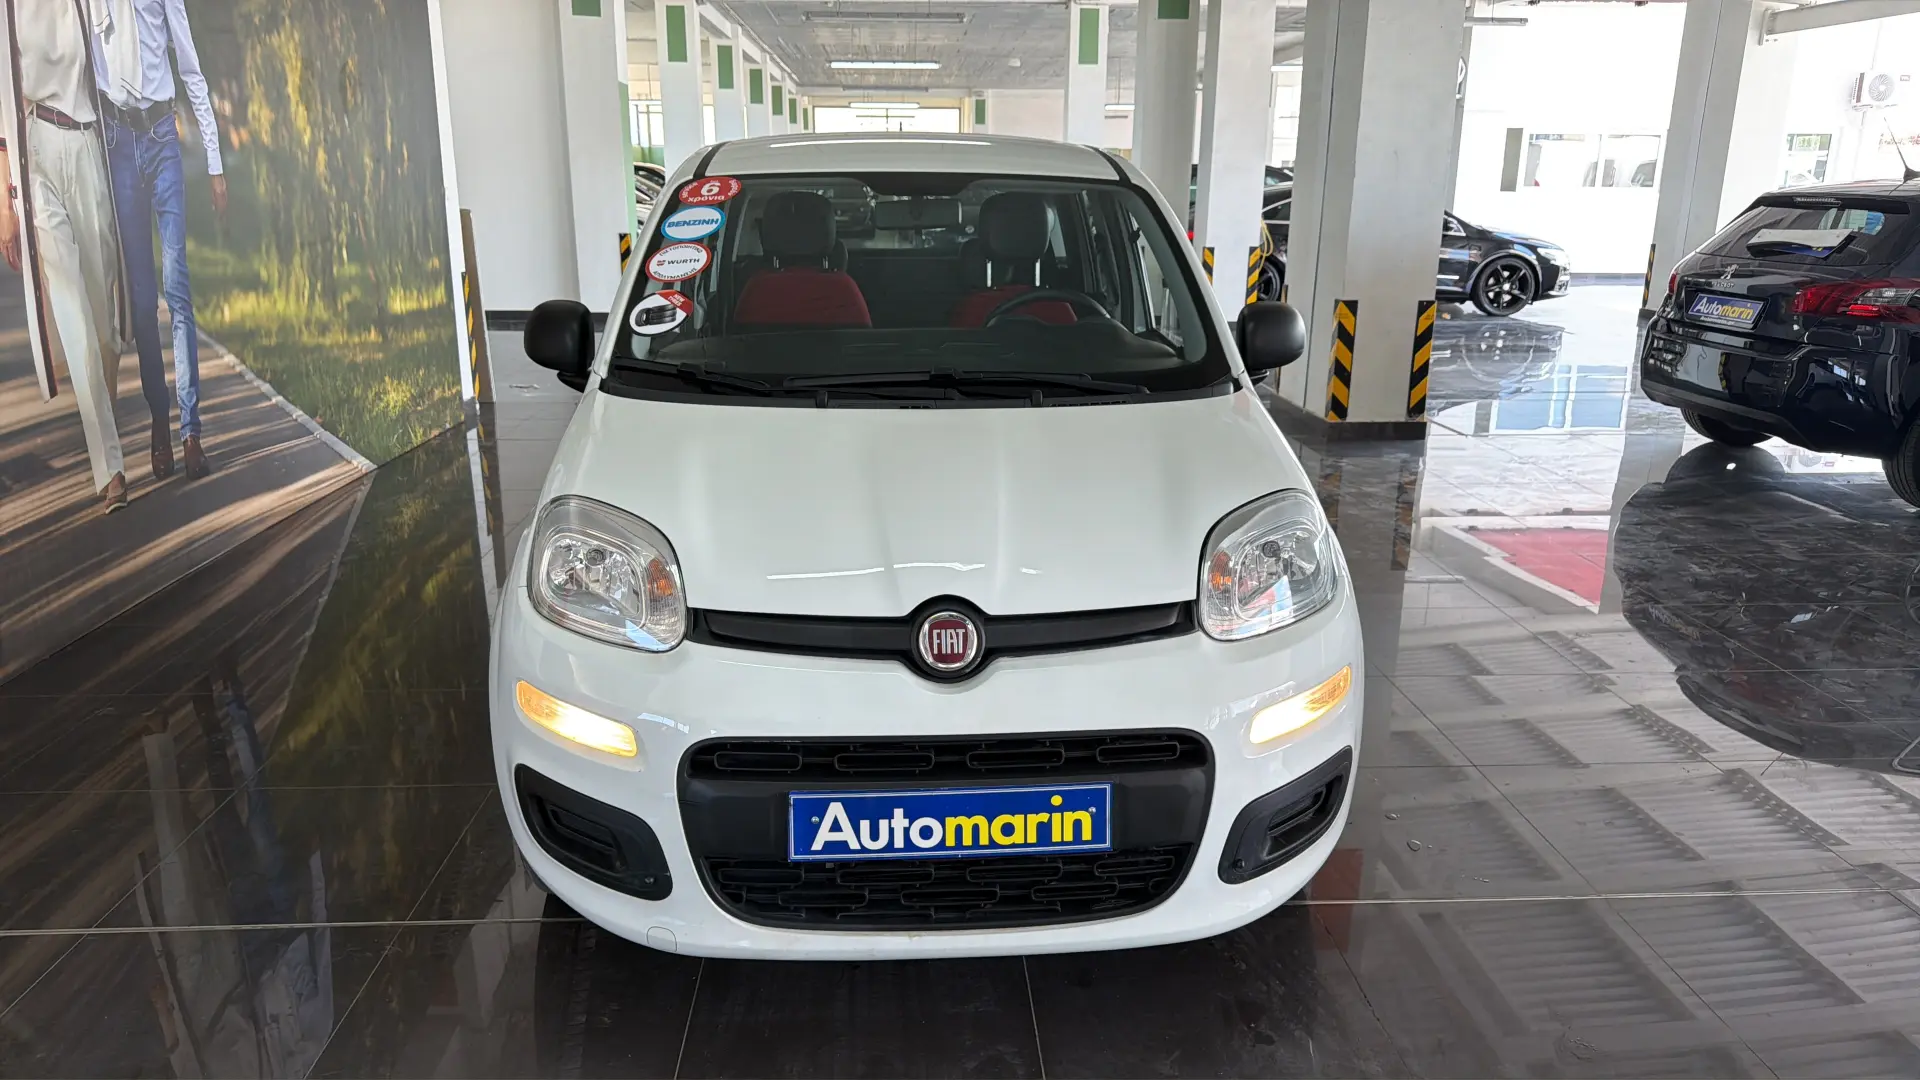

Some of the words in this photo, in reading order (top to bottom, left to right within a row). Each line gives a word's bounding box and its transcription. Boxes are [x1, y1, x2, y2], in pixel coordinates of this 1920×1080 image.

[700, 182, 721, 196] 6
[1693, 296, 1754, 320] Automarin
[932, 628, 966, 655] FIAT
[810, 794, 1093, 851] Automarin
